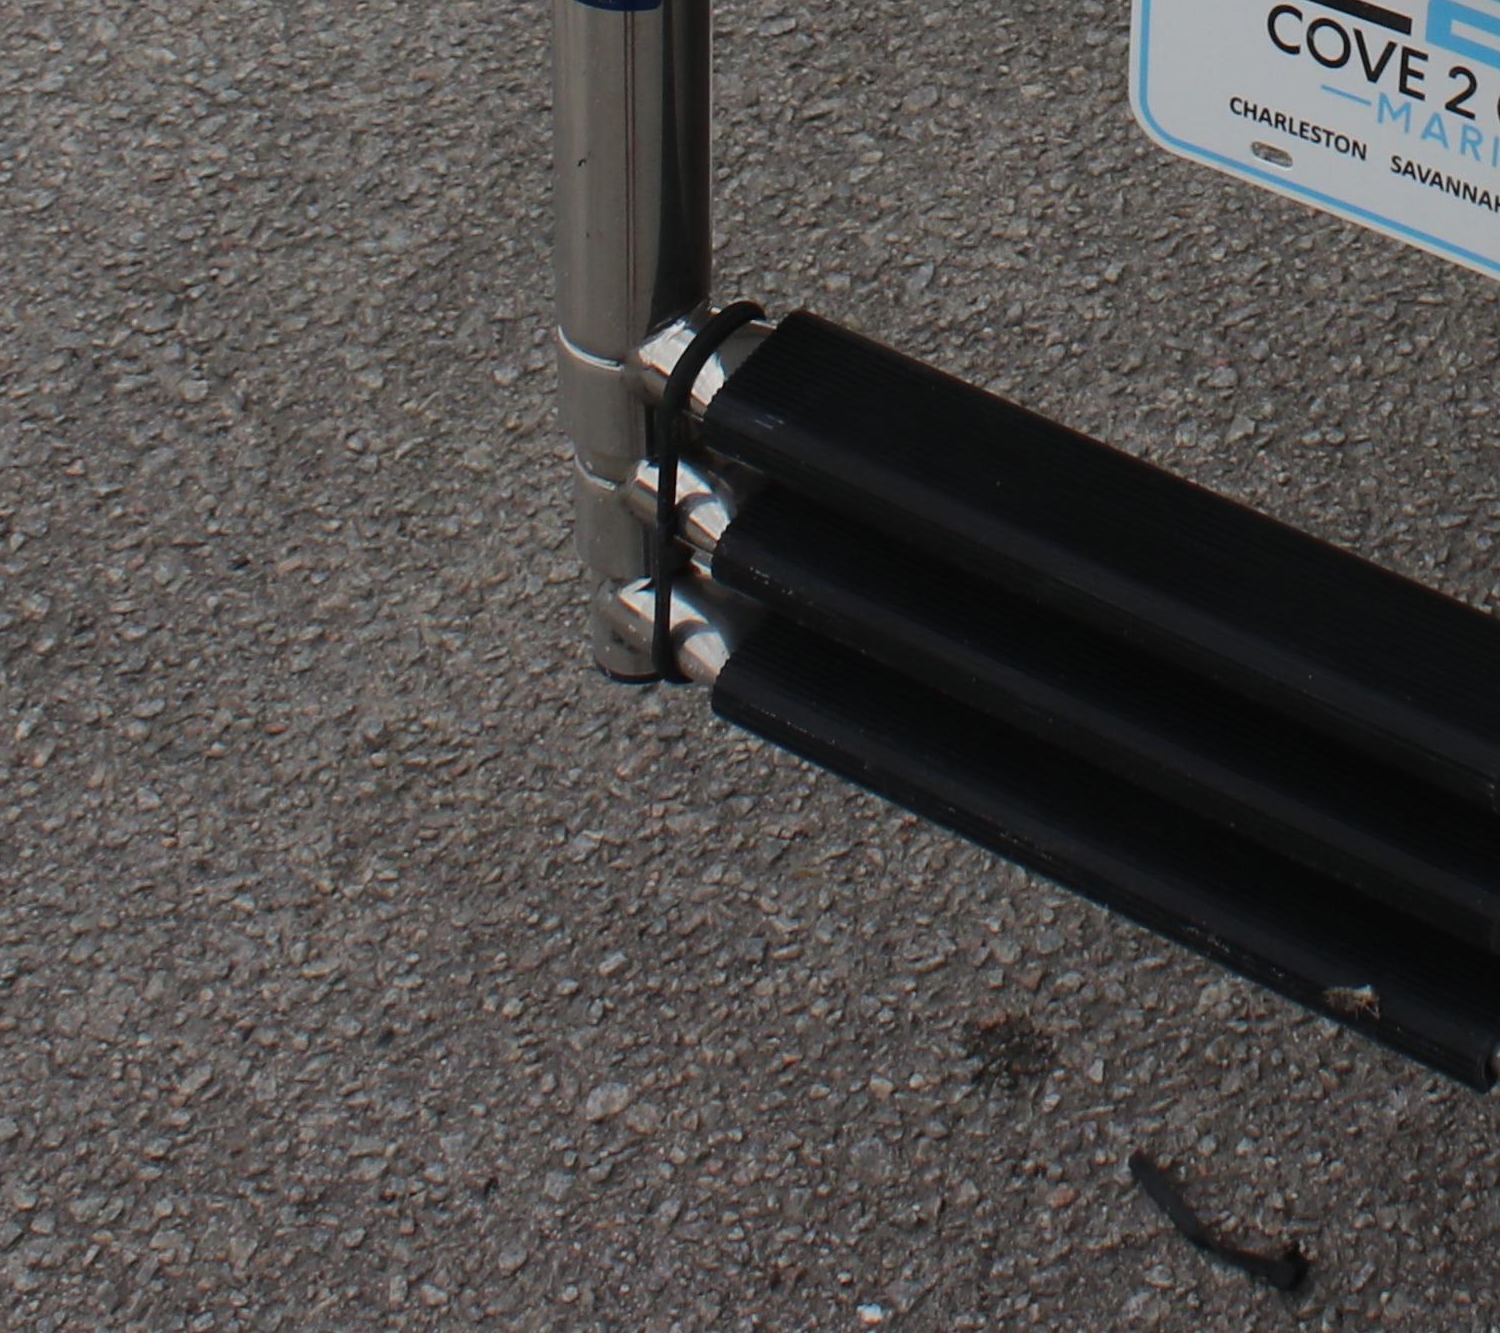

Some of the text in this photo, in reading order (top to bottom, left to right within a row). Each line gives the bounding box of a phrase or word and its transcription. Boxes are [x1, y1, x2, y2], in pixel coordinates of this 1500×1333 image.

[1267, 4, 1429, 101] COVE
[1444, 66, 1477, 120] 2
[1229, 96, 1368, 161] CHARLESTON
